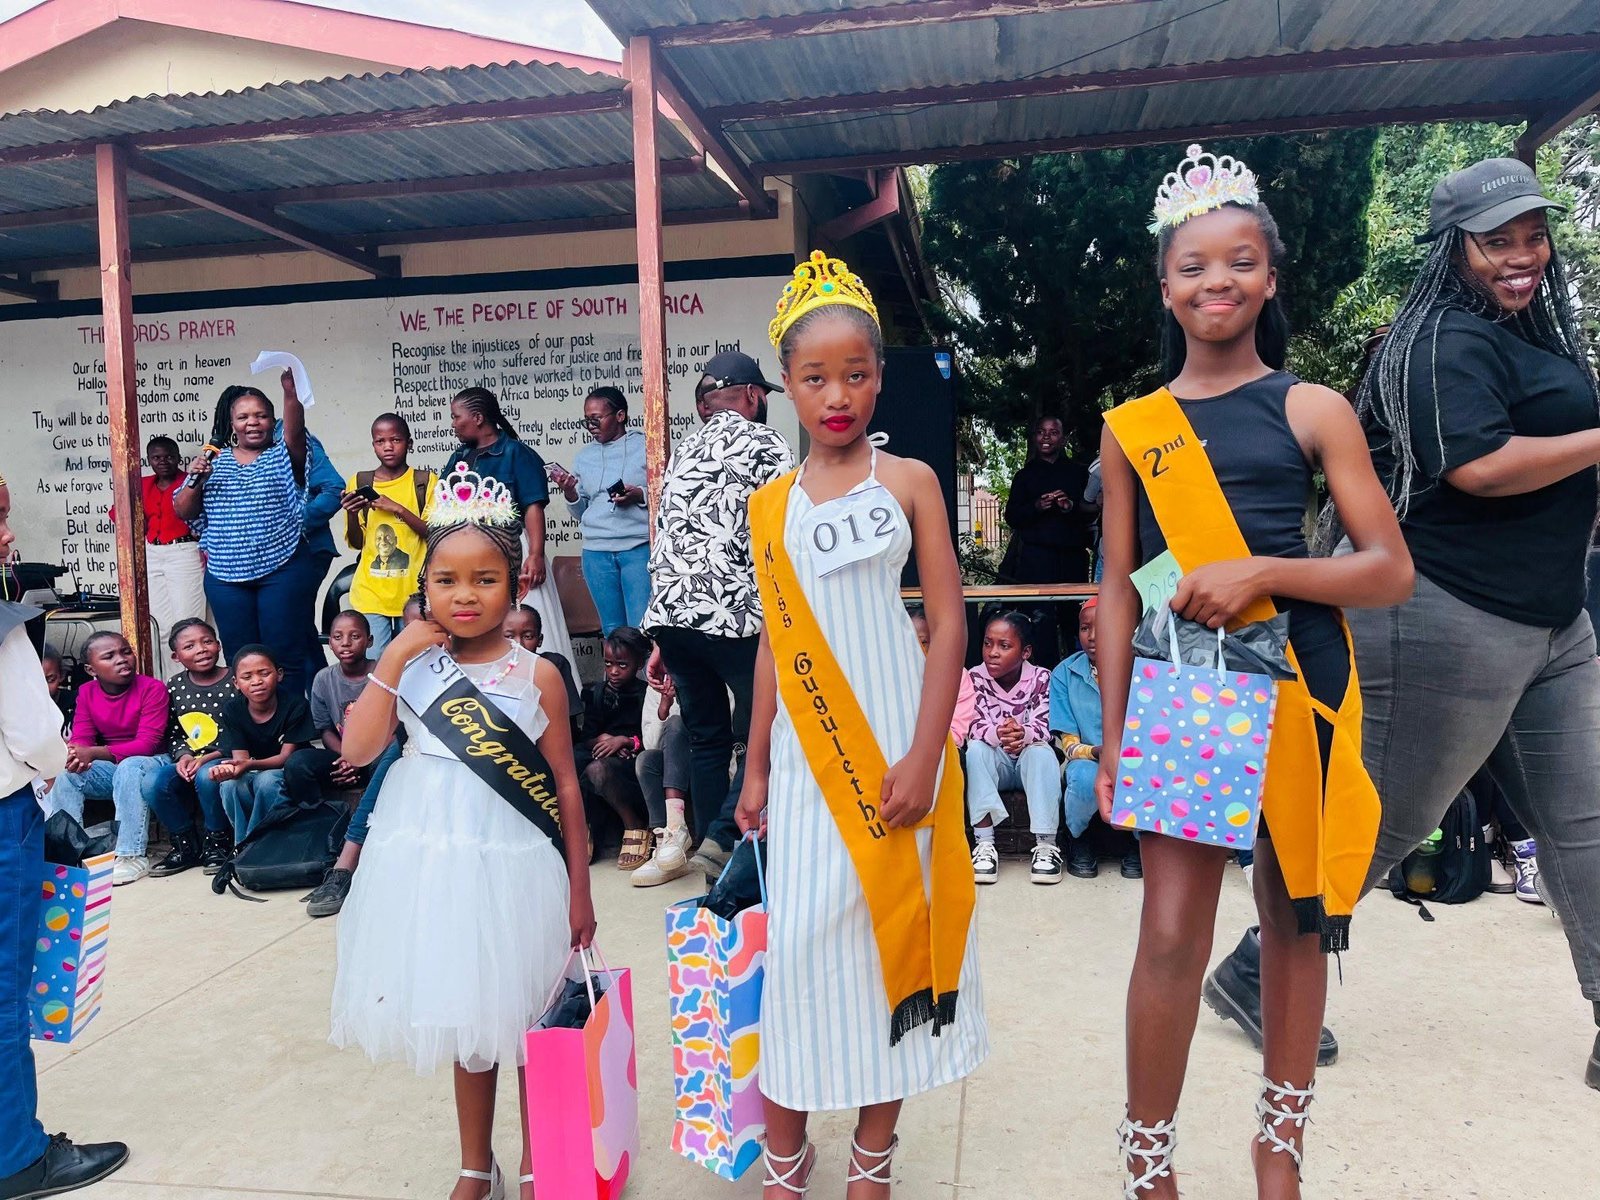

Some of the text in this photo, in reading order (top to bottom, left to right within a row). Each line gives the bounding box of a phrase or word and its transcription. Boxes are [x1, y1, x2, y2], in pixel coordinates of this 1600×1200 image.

[400, 293, 704, 333] WE, THE PEOPLE OF SOUTH RICA
[133, 320, 170, 342] ORD'S
[179, 319, 236, 341] PRAYER
[392, 333, 594, 361] Recognise the injustices of our past
[73, 362, 90, 375] Our
[136, 359, 148, 371] ho
[157, 359, 174, 371] art
[179, 356, 187, 370] in
[195, 355, 231, 369] heaven
[393, 361, 432, 377] Honour
[438, 359, 467, 373] those
[474, 356, 496, 370] who
[502, 352, 546, 368] suffered
[550, 350, 565, 364] for
[567, 350, 599, 367] justice
[603, 349, 622, 362] and
[677, 344, 686, 357] in
[690, 345, 710, 357] our
[153, 374, 171, 391] thy
[184, 375, 214, 386] name
[394, 377, 438, 395] Respect
[440, 375, 469, 391] those
[475, 374, 497, 388] who
[501, 371, 528, 387] have
[534, 368, 573, 384] worked
[580, 367, 592, 381] to
[595, 364, 620, 380] build
[173, 392, 200, 403] come
[395, 395, 414, 410] And
[418, 394, 447, 408] believe
[500, 387, 530, 401] Africa
[534, 385, 569, 402] belongs
[573, 383, 584, 397] to
[33, 411, 53, 432] Thy
[58, 412, 77, 426] will
[81, 411, 92, 425] be
[141, 411, 167, 424] earth
[172, 412, 185, 422] as
[188, 409, 196, 422] it
[199, 410, 208, 422] is
[433, 410, 442, 421] in
[519, 420, 543, 436] freely
[550, 418, 581, 431] elected
[668, 413, 695, 430] adopt
[53, 435, 77, 450] Give
[82, 437, 94, 448] us
[176, 429, 205, 446] daily
[417, 440, 463, 454] constitutio
[568, 432, 578, 444] of
[65, 457, 83, 472] And
[1143, 434, 1186, 478] 2nd
[37, 479, 51, 493] As
[54, 482, 68, 493] we
[71, 479, 103, 494] forgive
[66, 500, 108, 516] Lead us
[67, 519, 89, 535] But
[547, 517, 556, 529] in
[813, 507, 897, 553] 012
[61, 538, 110, 554] For thine
[545, 530, 570, 547] eople
[87, 557, 105, 572] the
[765, 541, 887, 840] Miss Gugulethu
